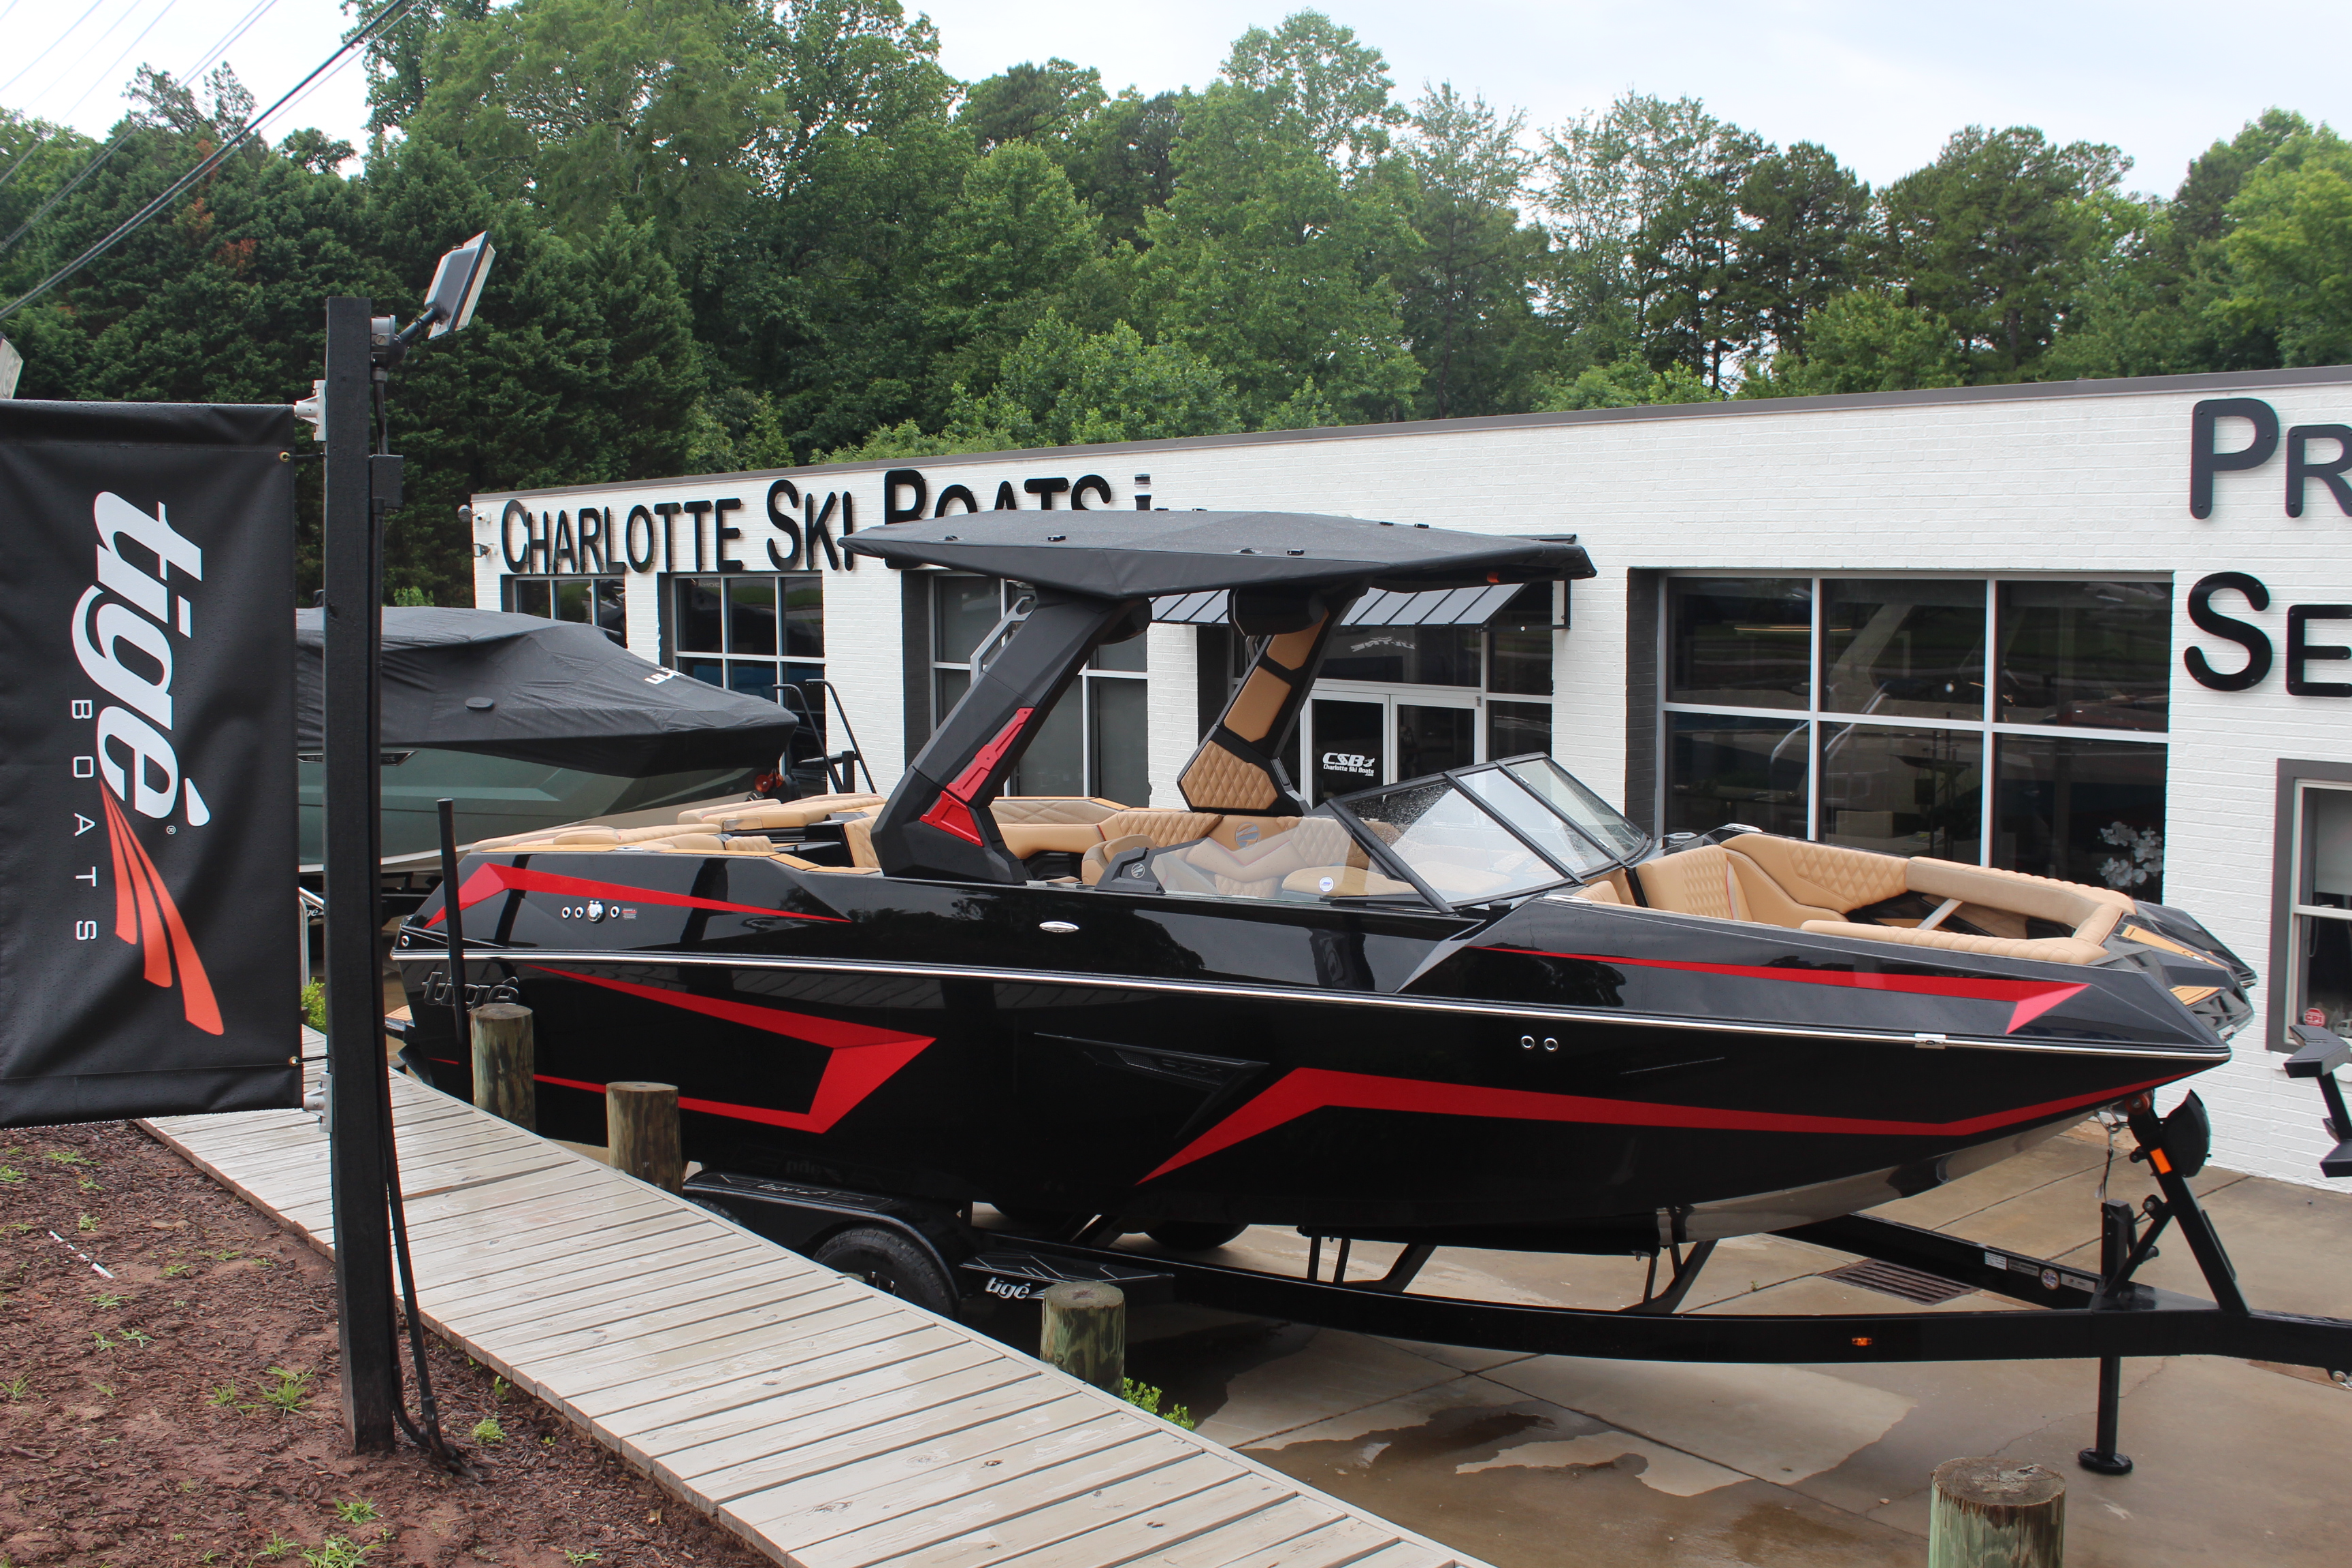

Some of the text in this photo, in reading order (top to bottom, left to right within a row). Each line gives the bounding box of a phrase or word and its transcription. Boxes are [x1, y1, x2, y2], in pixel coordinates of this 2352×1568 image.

[2190, 397, 2352, 519] PR
[501, 497, 745, 574] CHARLOTTE
[767, 479, 854, 571] SKI
[71, 491, 210, 826] tigé
[1322, 752, 1365, 767] CSB
[1323, 764, 1348, 772] Charlotte
[71, 699, 97, 941] BOATS
[985, 1277, 1031, 1299] tigé
